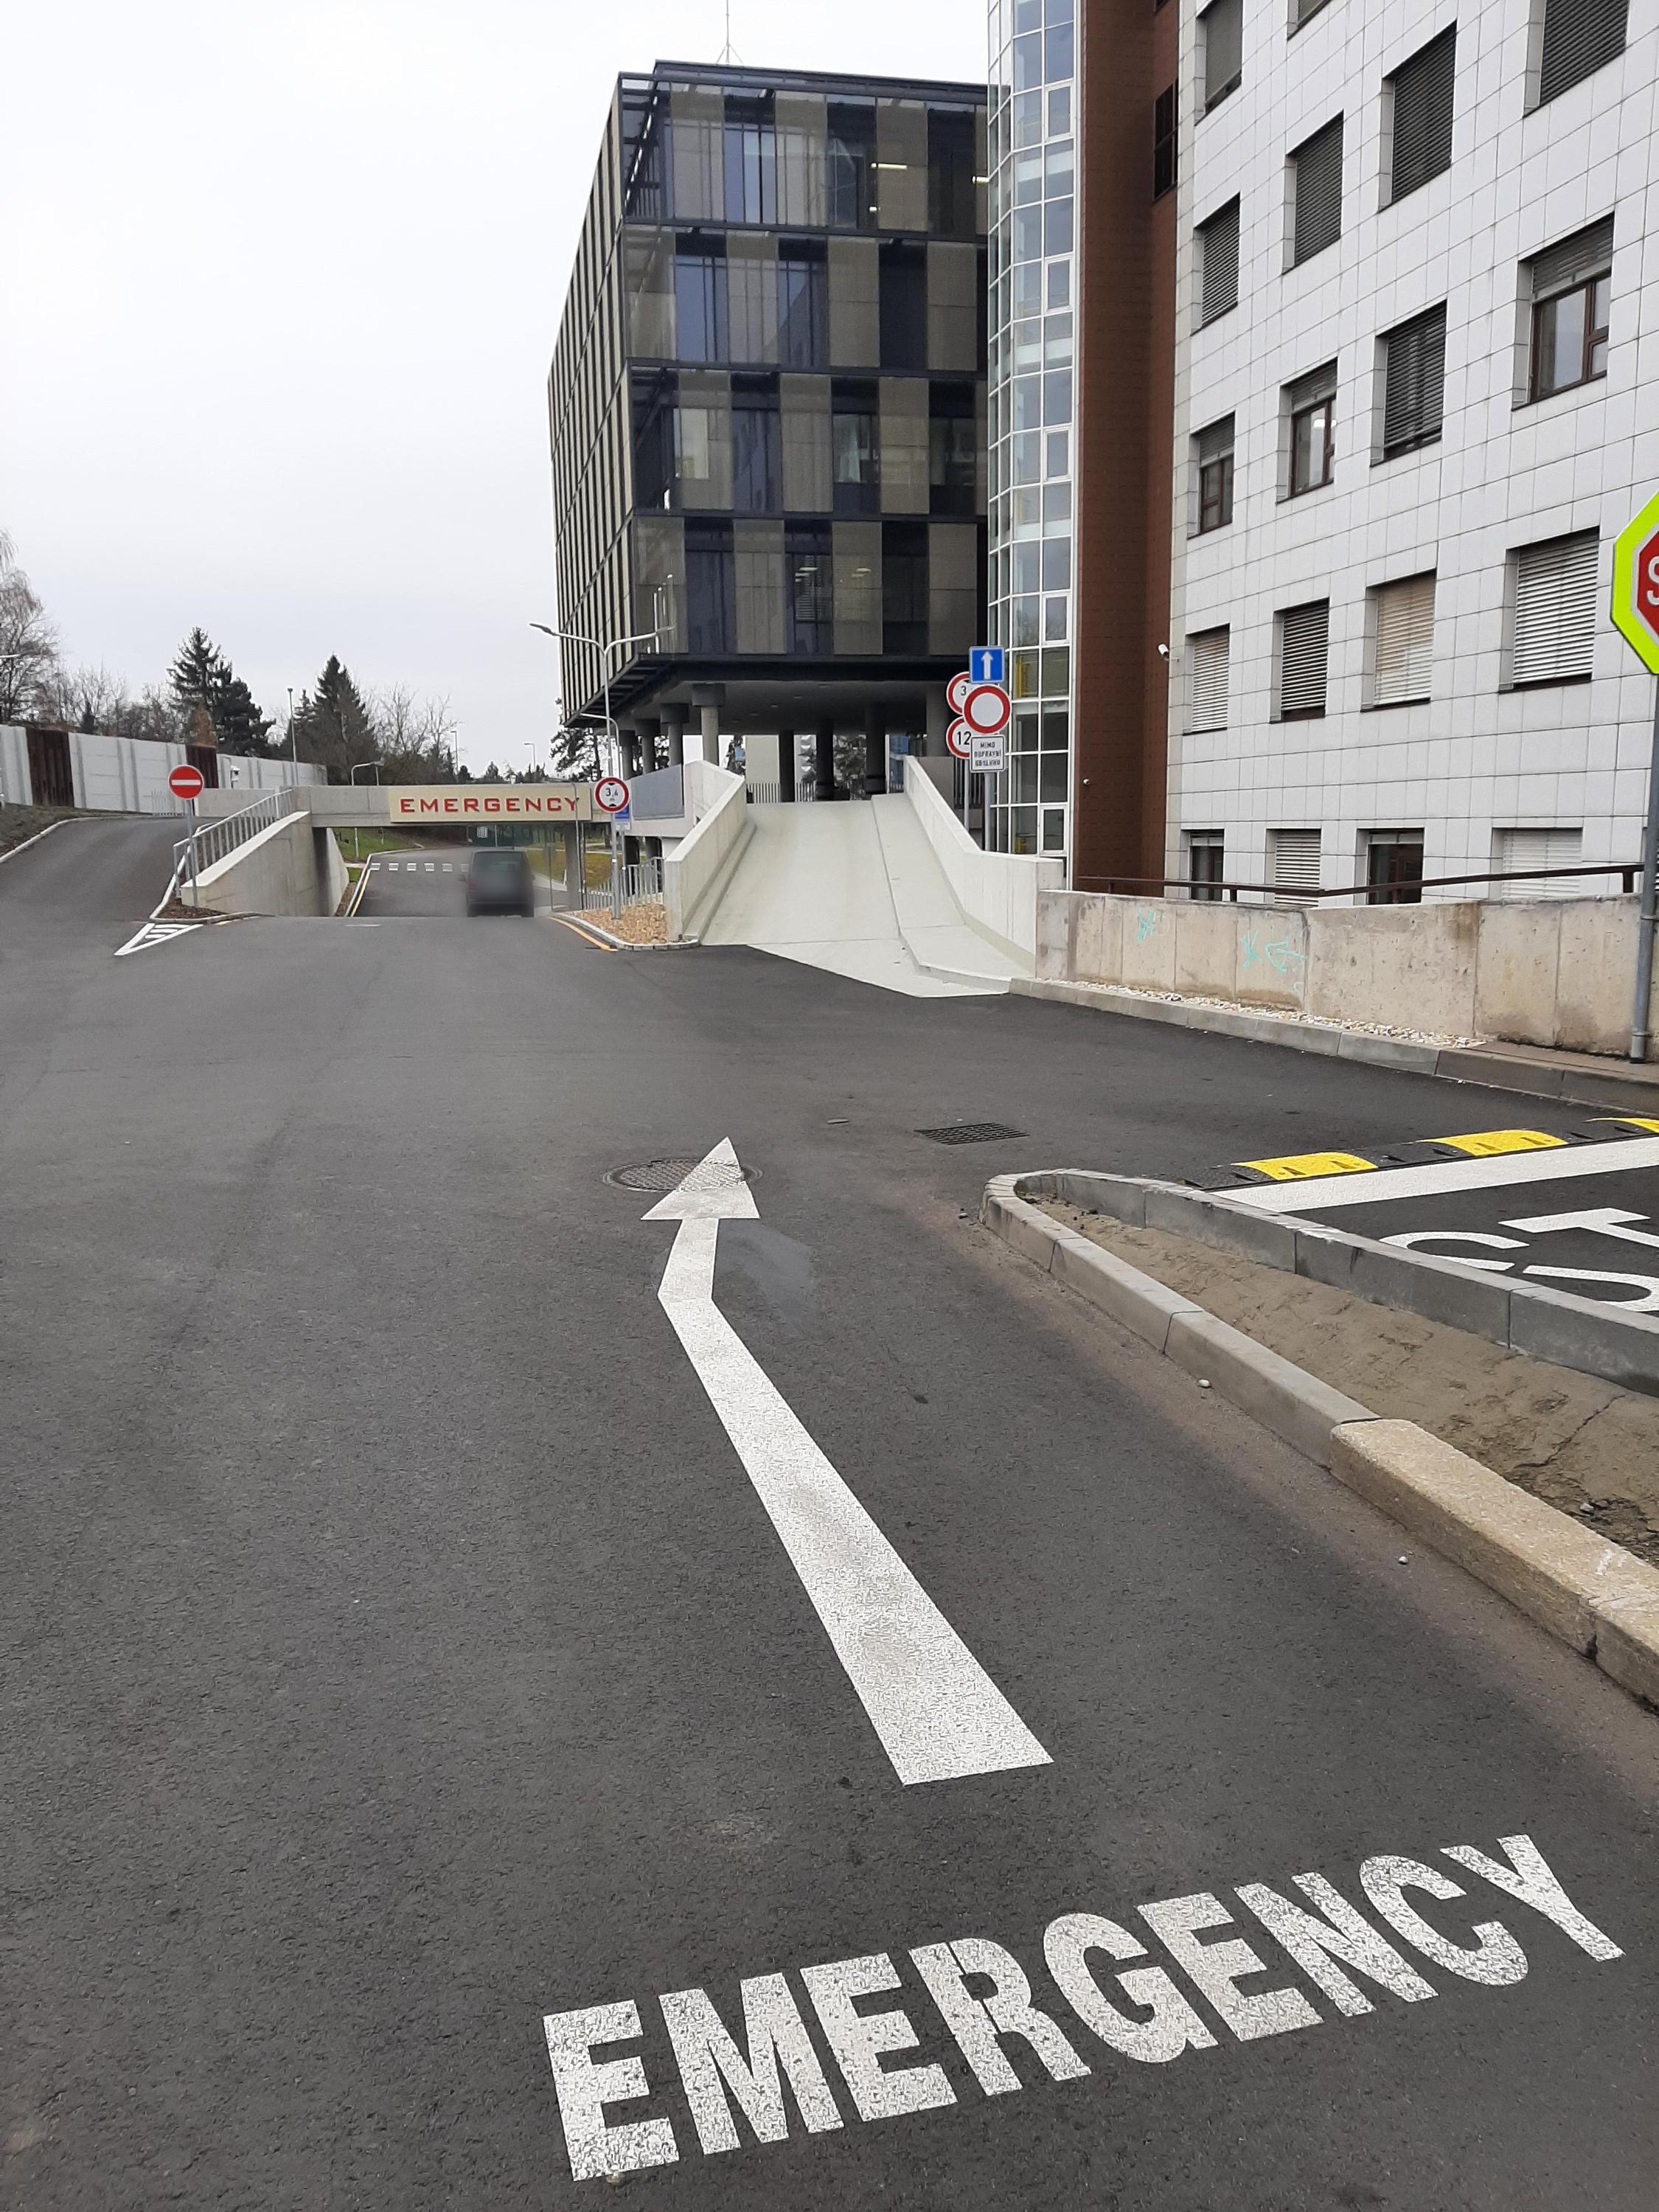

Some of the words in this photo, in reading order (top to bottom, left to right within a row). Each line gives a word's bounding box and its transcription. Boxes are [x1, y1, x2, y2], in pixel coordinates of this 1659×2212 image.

[956, 731, 972, 745] 12
[400, 797, 580, 813] EMERGENCY
[543, 1834, 1624, 2181] EMERGENCY
